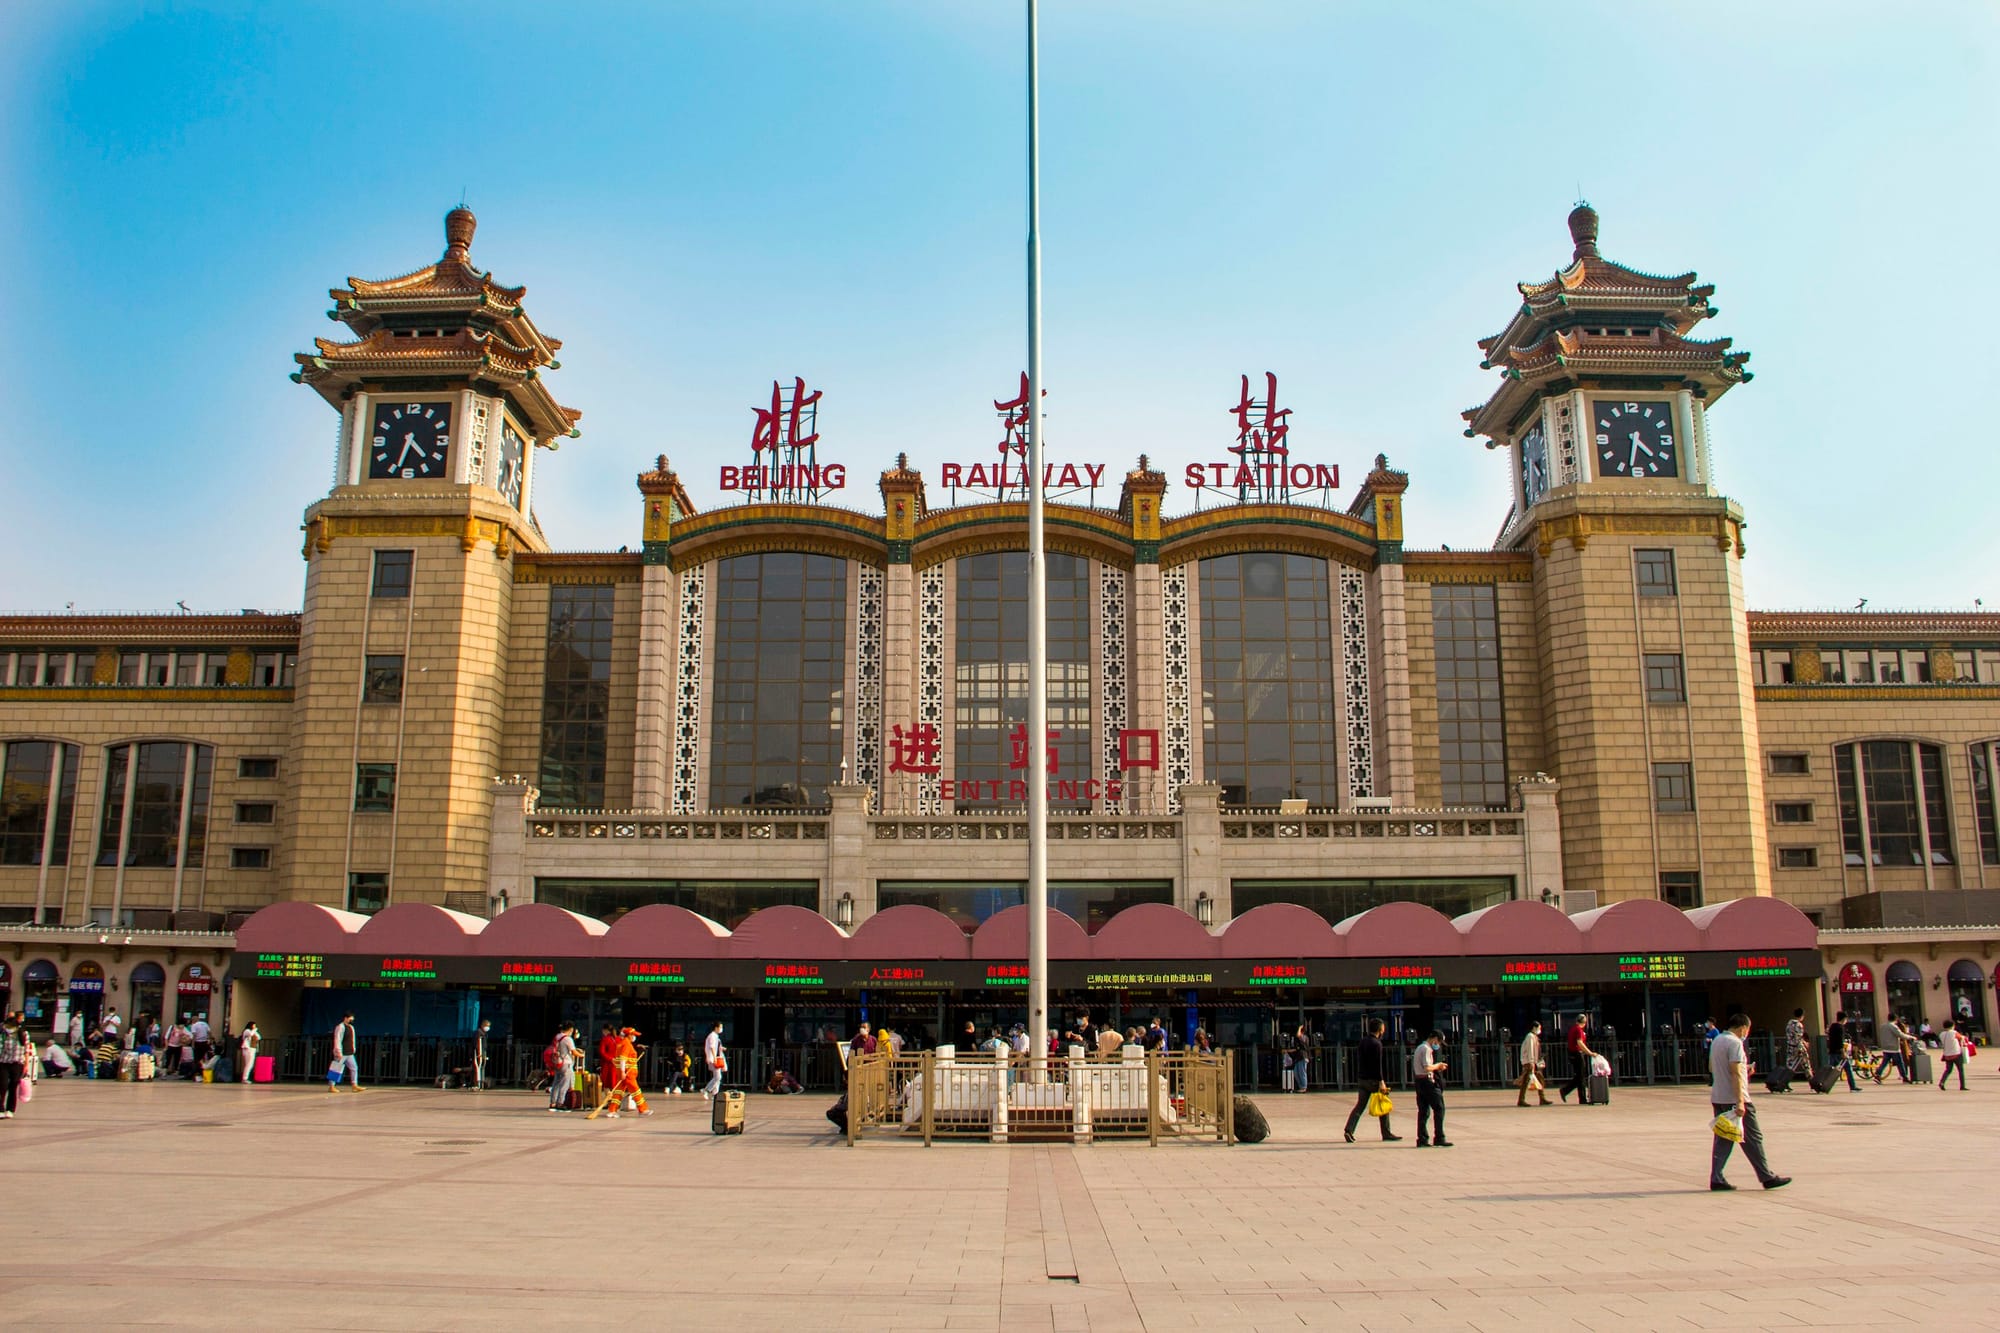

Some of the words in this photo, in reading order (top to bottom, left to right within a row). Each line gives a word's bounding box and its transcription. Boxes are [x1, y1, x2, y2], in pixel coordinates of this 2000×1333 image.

[406, 403, 422, 414] 12
[1624, 402, 1639, 413] 12
[373, 436, 386, 447] 9
[436, 435, 450, 446] 3
[1596, 434, 1609, 444] 9
[1660, 435, 1673, 445] 3
[402, 468, 415, 478] 6
[719, 463, 846, 489] BEIJING
[942, 463, 1106, 488] RAILWAY
[1185, 463, 1340, 489] STATION
[1632, 466, 1645, 477] 6
[888, 723, 1160, 775] 进站口
[941, 780, 1121, 801] ENTRNCE
[383, 958, 433, 970] 自助进站口
[502, 962, 554, 974] 自助进站口
[628, 962, 682, 974] 自助进站口
[1505, 961, 1557, 973] 自助进站口
[1737, 957, 1788, 968] 自助进站口
[765, 964, 819, 976] 自助进站口
[870, 967, 925, 979] 人工进站口
[987, 964, 1030, 977] 自助进站
[1253, 965, 1306, 977] 自助进站口
[1379, 966, 1432, 977] 自助进站口
